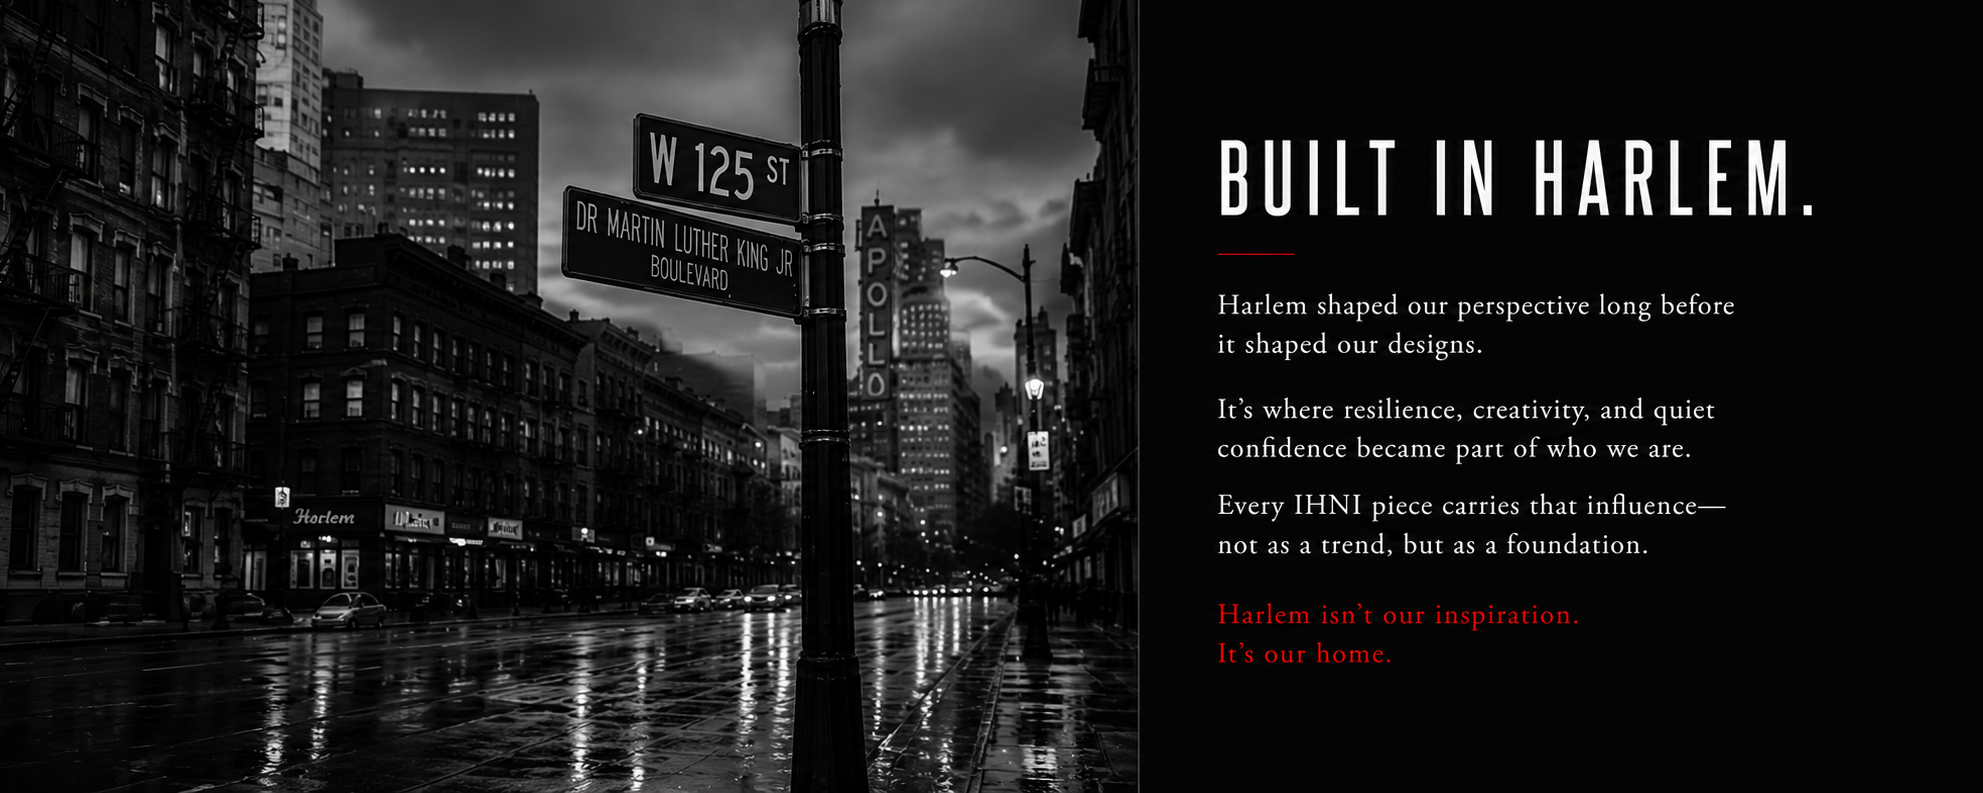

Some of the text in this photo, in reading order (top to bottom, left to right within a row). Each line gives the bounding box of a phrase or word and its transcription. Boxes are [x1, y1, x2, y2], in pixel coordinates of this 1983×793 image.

[649, 131, 790, 201] W 125 ST
[576, 200, 793, 277] DR MARTIN LUTHER KING JR
[650, 254, 729, 292] BOULEVARD
[865, 213, 888, 396] APOLLO
